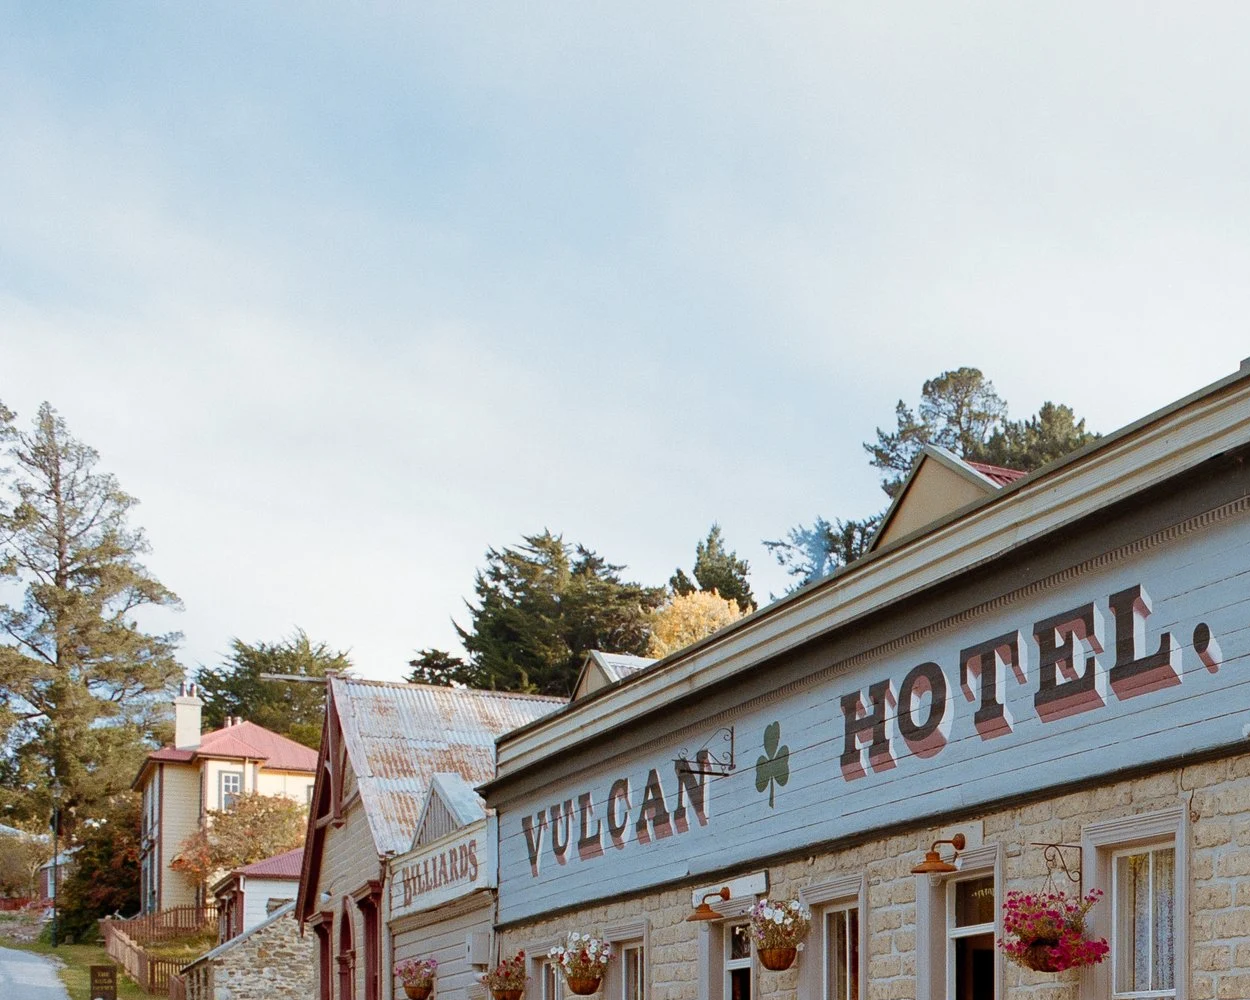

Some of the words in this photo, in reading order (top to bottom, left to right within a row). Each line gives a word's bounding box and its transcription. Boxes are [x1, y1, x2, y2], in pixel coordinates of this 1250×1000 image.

[521, 749, 713, 878] VULCAN
[840, 583, 1223, 783] HOTEL.
[402, 839, 478, 908] BILLIARDS
